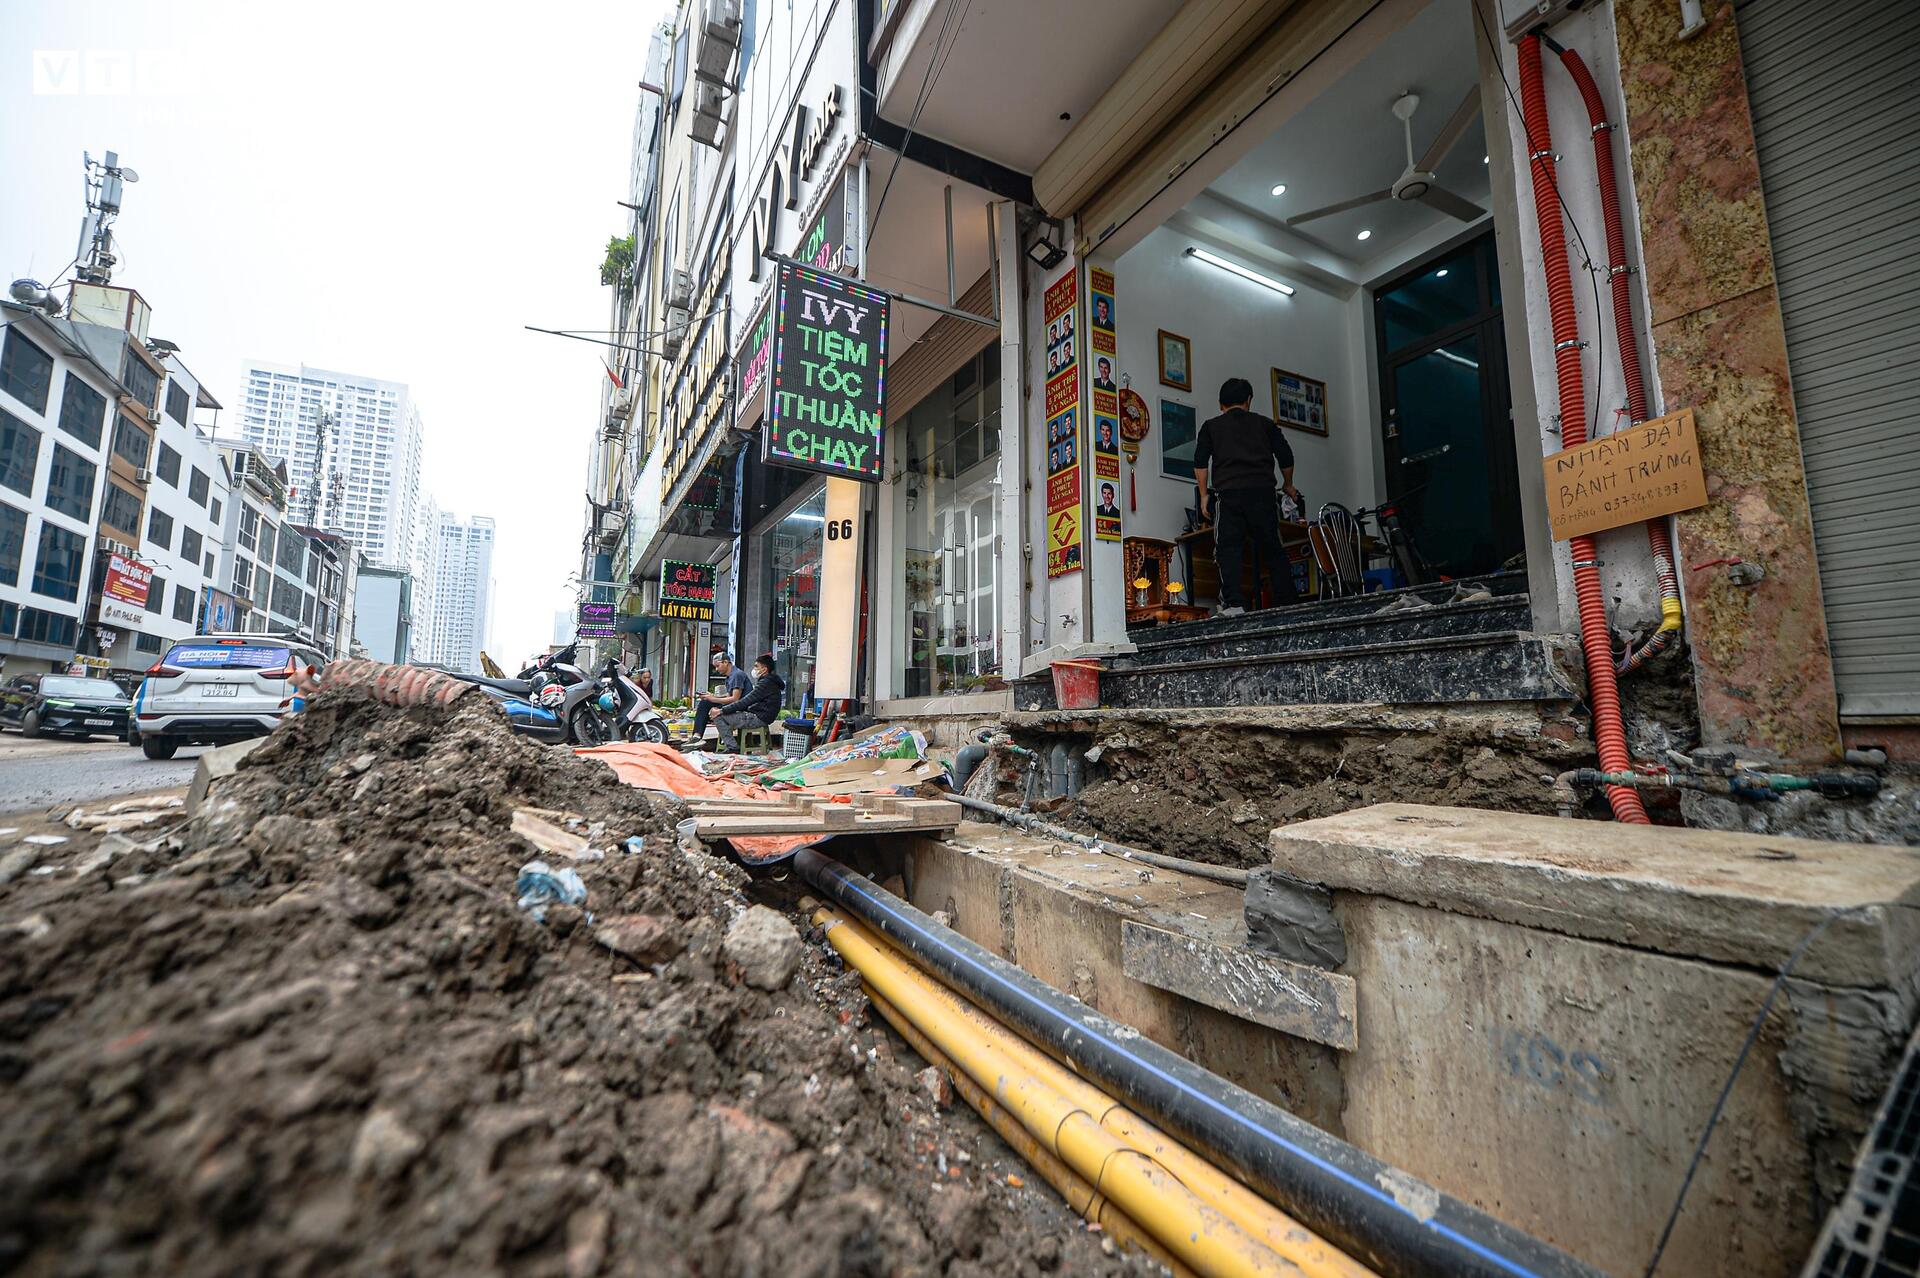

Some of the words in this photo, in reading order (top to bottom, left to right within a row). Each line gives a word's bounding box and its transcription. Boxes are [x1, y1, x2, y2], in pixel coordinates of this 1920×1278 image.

[800, 289, 869, 335] IVY
[796, 323, 868, 367] TIỆM
[800, 359, 863, 398] TÓC
[786, 428, 869, 471] CHAY
[1557, 438, 1630, 474] NHẬN
[1560, 470, 1617, 509] BÁNH
[827, 519, 853, 541] 66
[1048, 551, 1061, 567] 64
[661, 601, 680, 617] LẤY
[680, 604, 698, 619] RÁY
[699, 607, 713, 620] TAI
[688, 585, 713, 600] NAM
